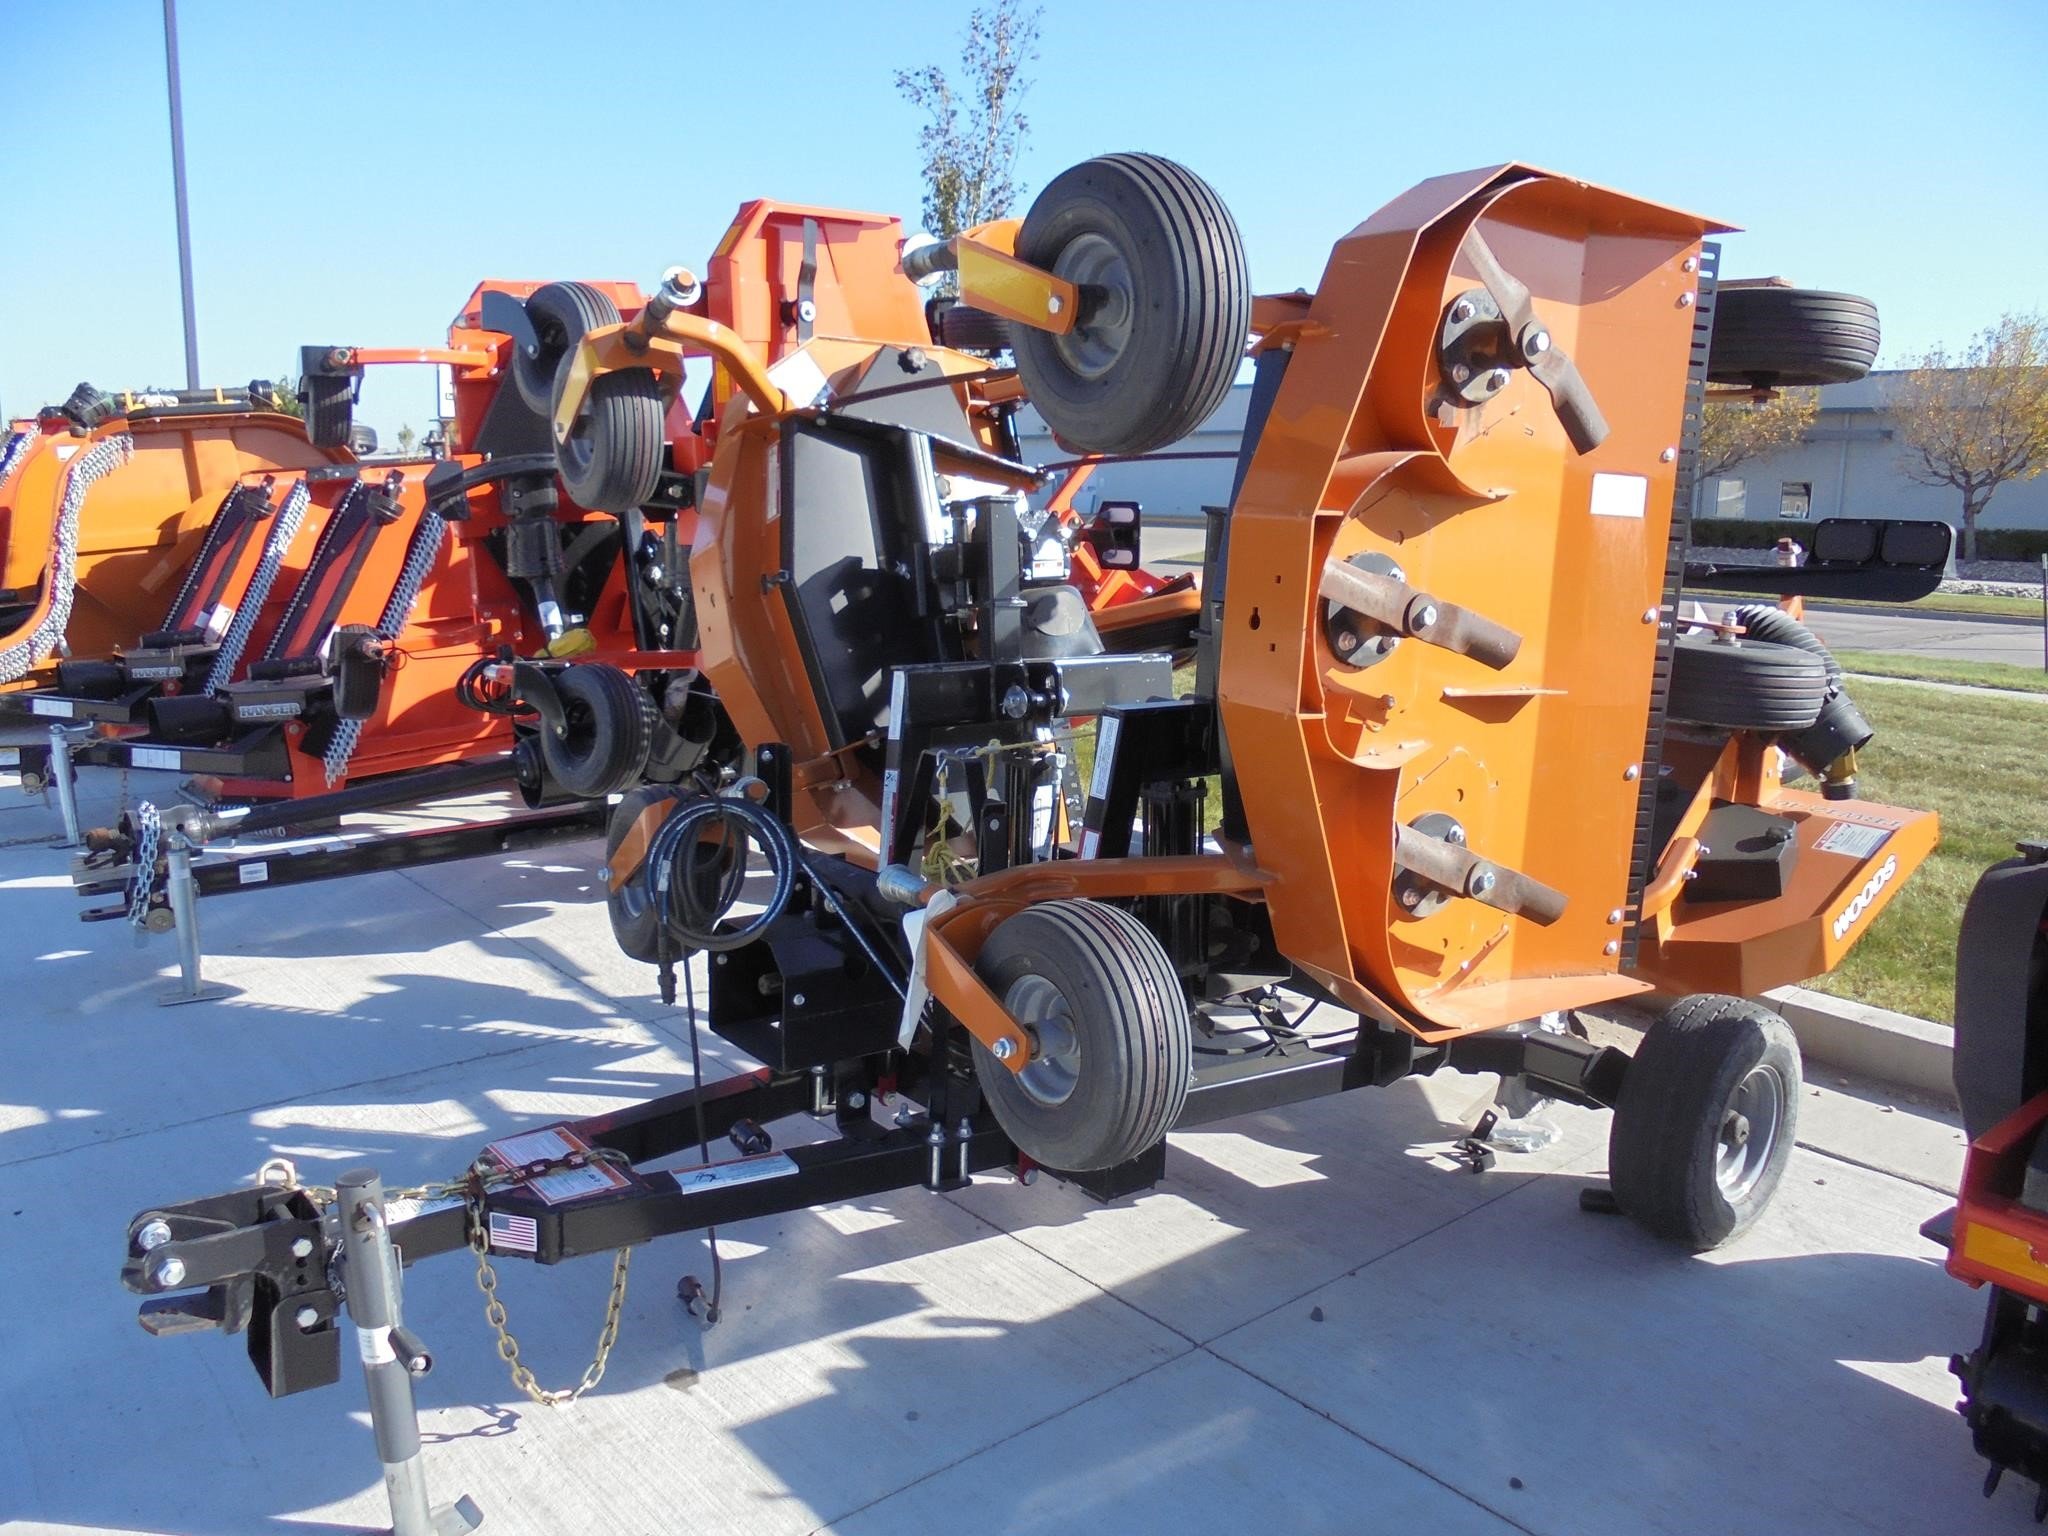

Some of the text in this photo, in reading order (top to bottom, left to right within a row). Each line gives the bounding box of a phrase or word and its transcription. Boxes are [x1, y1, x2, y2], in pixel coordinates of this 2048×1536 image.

[132, 666, 183, 679] RANGER
[240, 703, 301, 718] RANGER
[1833, 854, 1896, 940] WOODS
